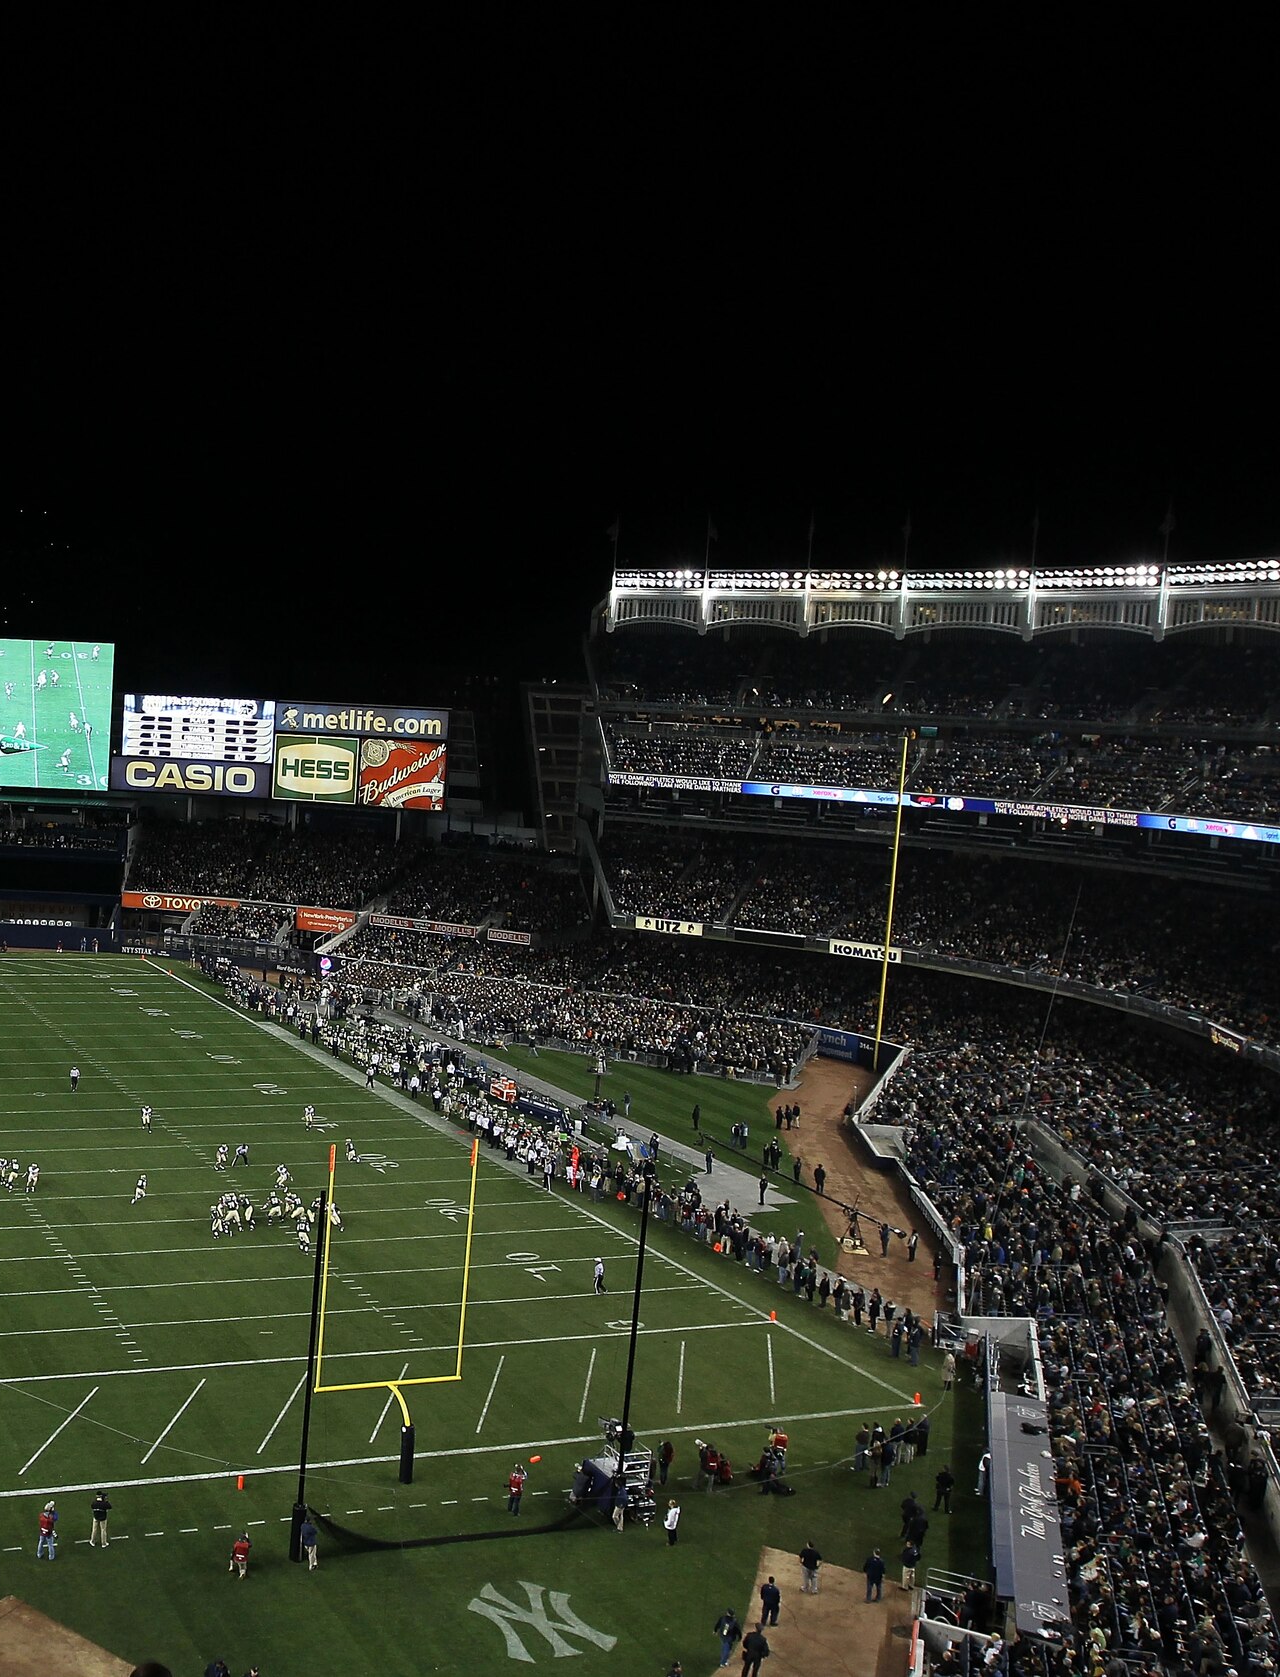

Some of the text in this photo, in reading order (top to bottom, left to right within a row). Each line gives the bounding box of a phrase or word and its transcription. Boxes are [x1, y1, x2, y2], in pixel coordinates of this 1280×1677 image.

[302, 709, 442, 735] metlife.com
[125, 761, 256, 793] CASIO
[282, 757, 350, 781] HESS
[363, 743, 447, 804] Budweiser
[622, 779, 654, 787] FOLLOWING
[646, 775, 674, 784] ATHLETICS
[391, 788, 421, 804] American
[422, 786, 441, 794] Lager
[771, 785, 894, 803] G xerox Sprint
[1009, 808, 1047, 818] FOLLOWING
[1049, 811, 1067, 819] TEAM
[1068, 813, 1087, 821] NOTRE
[1089, 815, 1106, 823] DAME
[1107, 817, 1138, 826] PARTNERS
[1016, 803, 1035, 811] DAME
[1036, 804, 1069, 813] ATHLETICS
[1070, 807, 1092, 816] WOULD
[1116, 811, 1138, 820] THANK
[1168, 818, 1177, 829] G
[1205, 824, 1223, 832] xerox
[373, 916, 409, 927] MODELL'S
[434, 924, 472, 935] MODELL'S
[655, 919, 681, 933] UTZ
[489, 931, 529, 942] MODELL'S
[833, 944, 897, 961] KOMATSU
[822, 1034, 847, 1046] ynch
[425, 1198, 471, 1216] 20
[505, 1252, 562, 1274] 10
[1017, 1462, 1057, 1541] New York Yankees
[467, 1580, 618, 1664] NY
